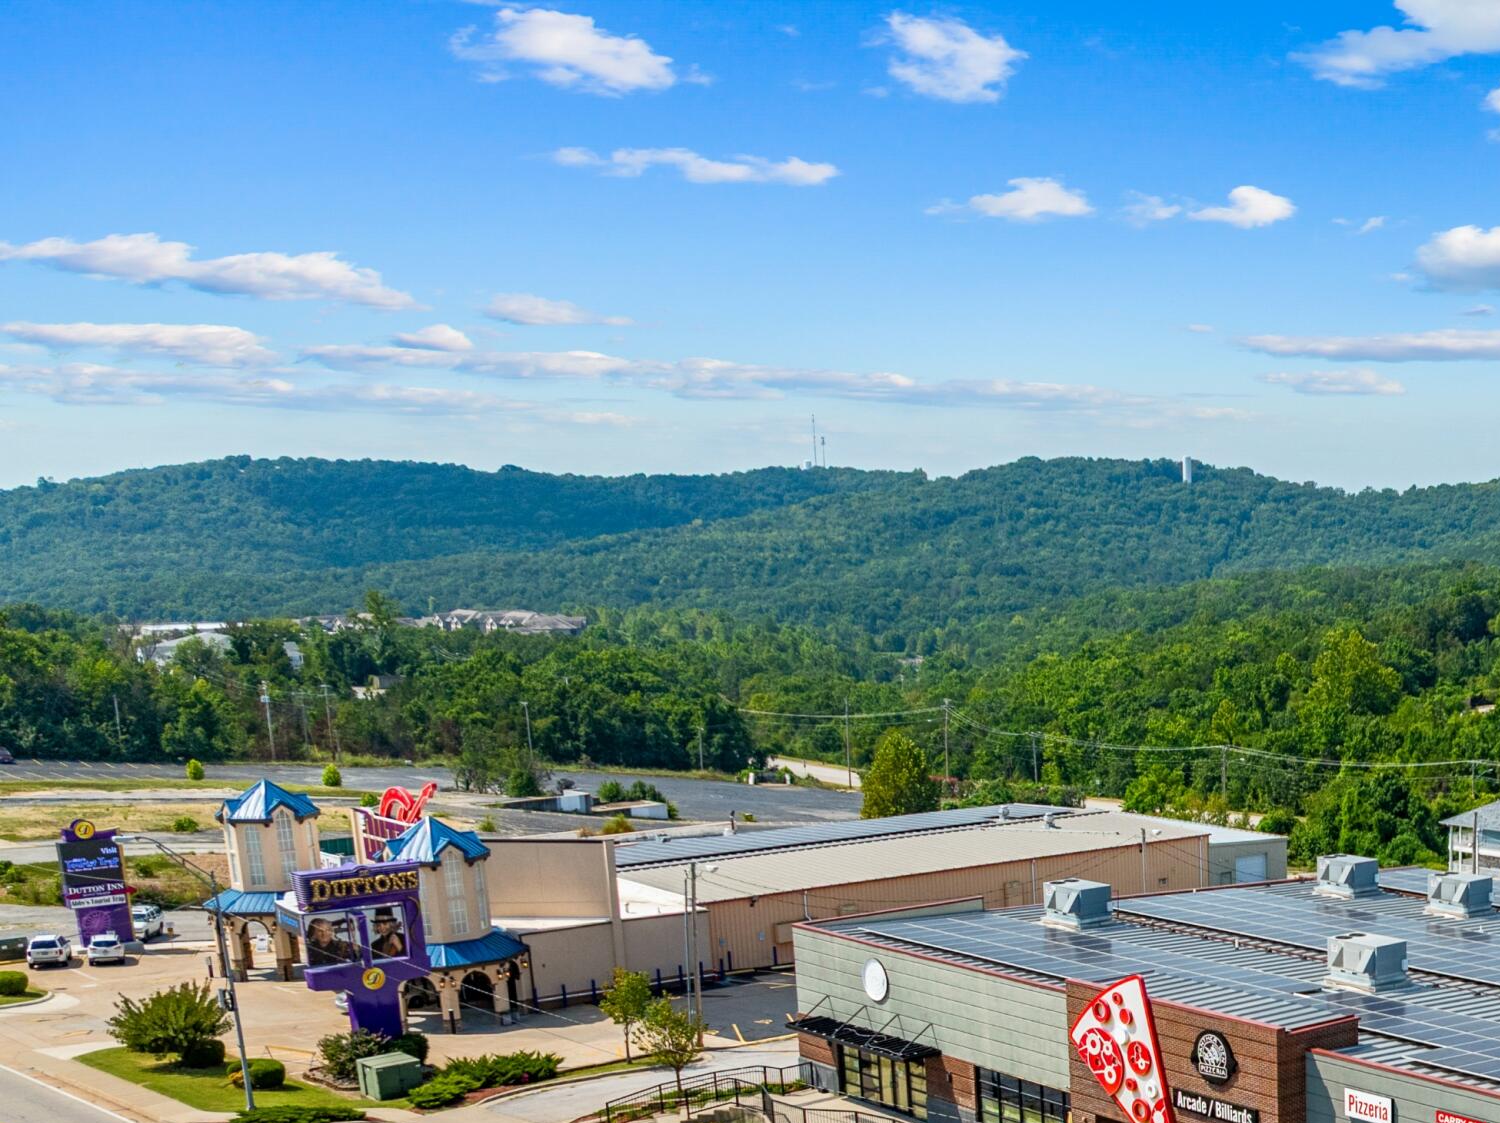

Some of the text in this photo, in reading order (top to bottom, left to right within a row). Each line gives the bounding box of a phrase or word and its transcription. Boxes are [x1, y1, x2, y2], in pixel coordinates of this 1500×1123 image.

[68, 885, 105, 895] DUTTON
[107, 883, 124, 891] INN
[311, 871, 417, 902] DUTTONS
[1177, 1091, 1207, 1114] Arcade
[1208, 1100, 1214, 1117] /
[1348, 1094, 1388, 1121] Pizzeria
